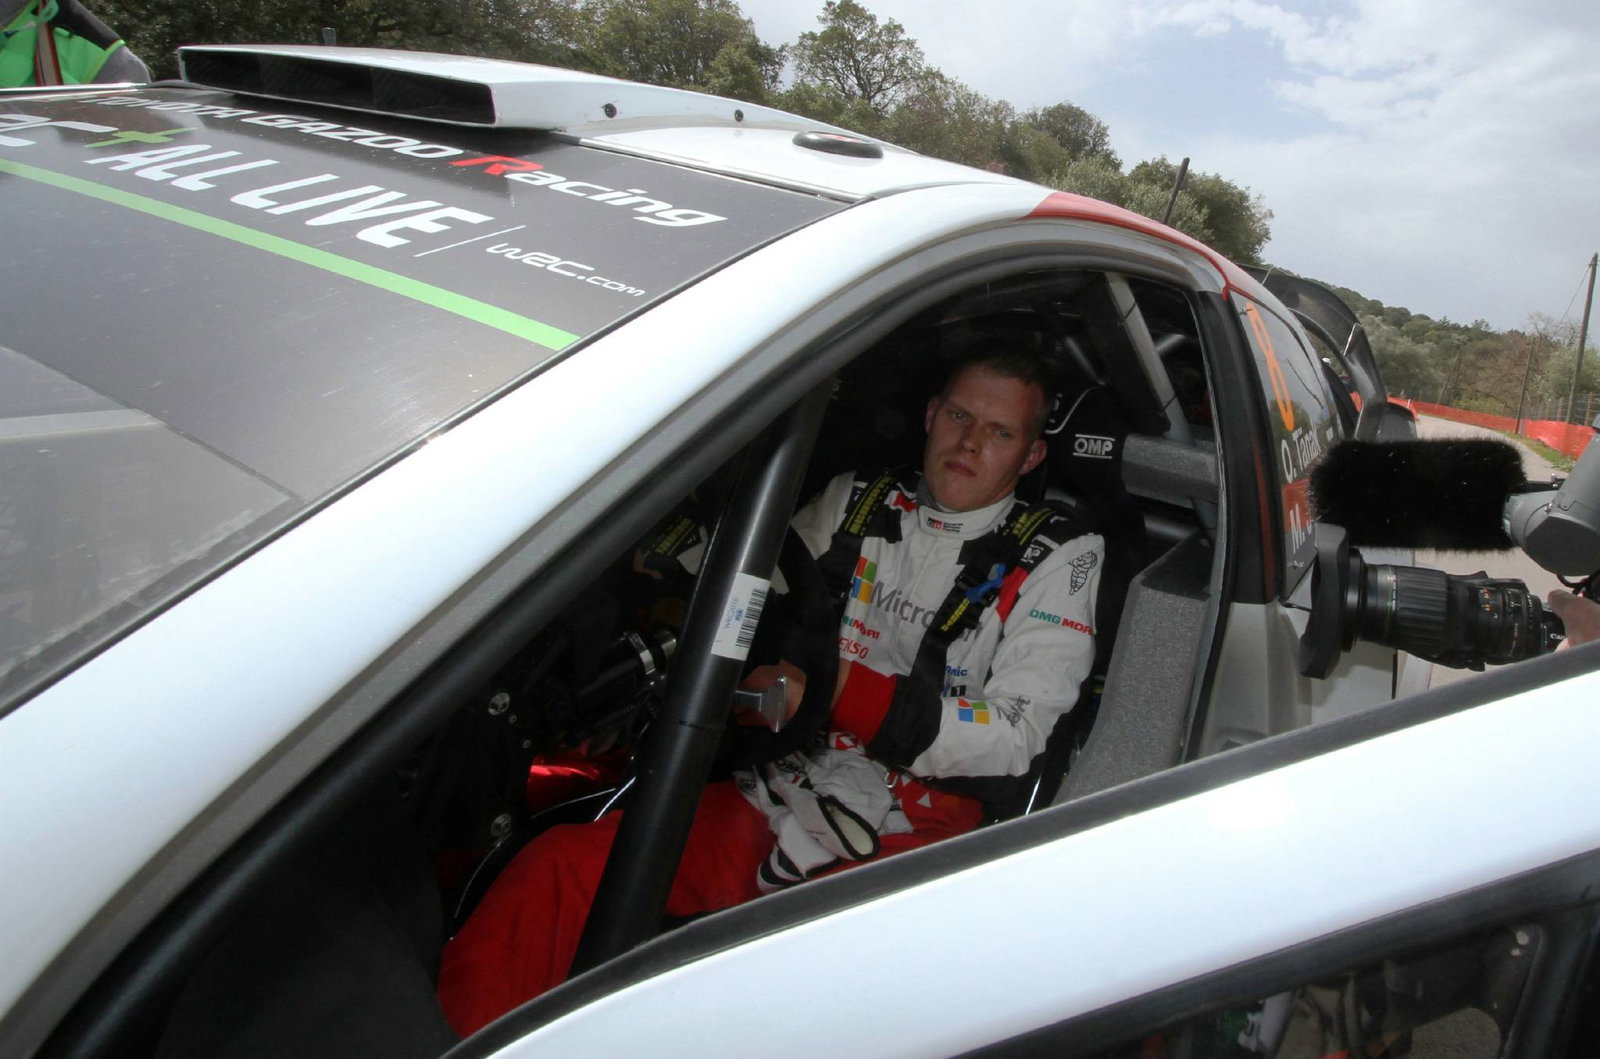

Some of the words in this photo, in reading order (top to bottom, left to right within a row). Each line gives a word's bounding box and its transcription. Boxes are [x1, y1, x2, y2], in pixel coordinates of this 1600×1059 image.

[240, 113, 463, 159] GAZOO
[450, 154, 728, 227] Racing
[83, 144, 280, 191] ALL
[230, 173, 495, 249] LIVE
[1073, 436, 1113, 457] OMP
[870, 580, 937, 628] Micro
[1029, 608, 1061, 624] DMG
[1061, 618, 1096, 636] MOR
[839, 636, 869, 659] ENSO
